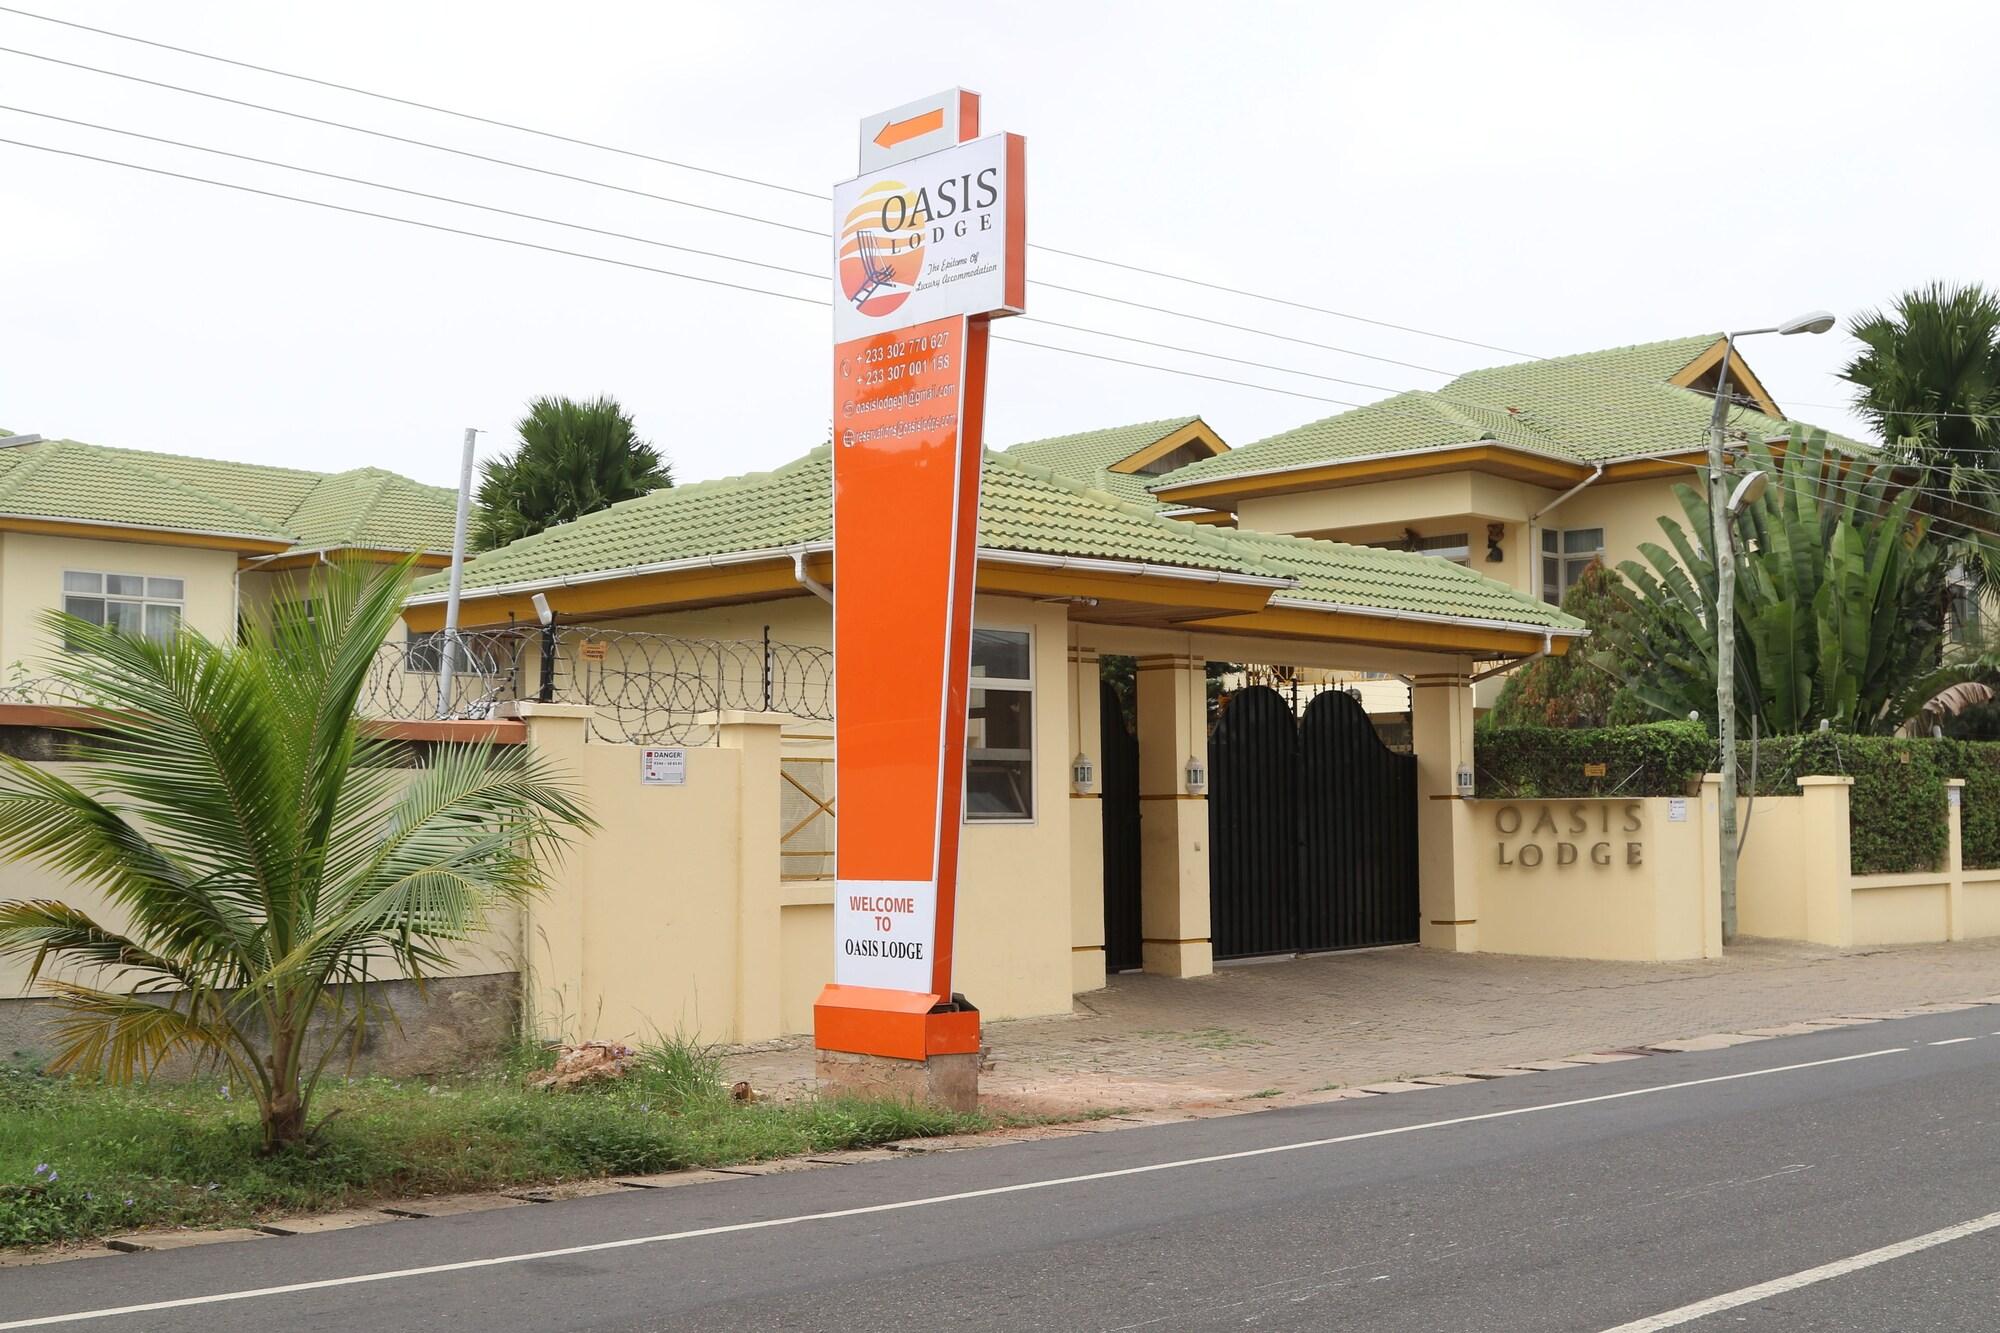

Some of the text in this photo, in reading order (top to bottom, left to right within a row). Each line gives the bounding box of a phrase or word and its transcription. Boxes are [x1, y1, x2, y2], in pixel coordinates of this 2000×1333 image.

[881, 167, 998, 233] OASIS
[891, 213, 992, 255] LODGE
[915, 264, 997, 292] Luxury Accommodation
[928, 263, 940, 276] The
[941, 257, 968, 272] Epitome
[887, 342, 905, 359] 302
[909, 338, 927, 354] 770
[930, 332, 950, 349] 627
[887, 364, 906, 381] 307
[909, 360, 927, 376] 001
[933, 354, 950, 373] 158
[1495, 804, 1643, 835] OASIS
[1498, 842, 1644, 868] LODGE
[849, 896, 914, 914] WELCOME
[875, 916, 892, 932] TO
[845, 938, 923, 960] OASIS LODGE
